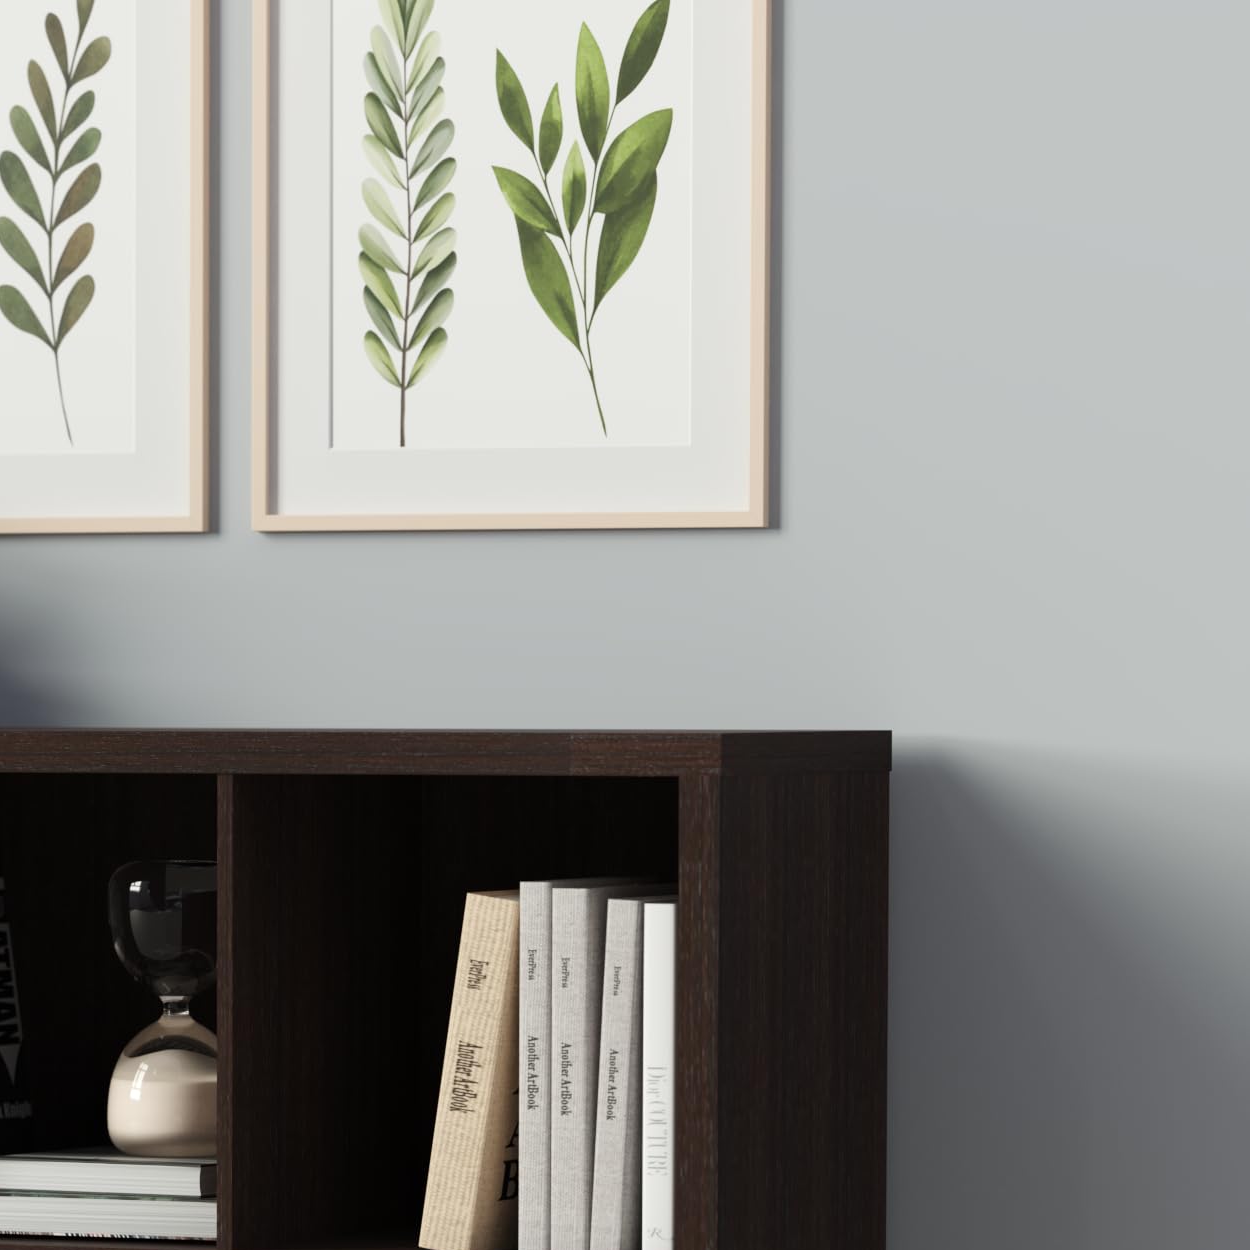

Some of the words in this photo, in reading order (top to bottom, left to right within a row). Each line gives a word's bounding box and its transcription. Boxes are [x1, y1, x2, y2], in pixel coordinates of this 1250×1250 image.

[466, 958, 490, 990] EverPress
[527, 949, 538, 981] EverPress
[561, 957, 571, 988] EverPress
[613, 965, 622, 996] EverPress
[455, 1039, 484, 1076] Another
[527, 1035, 540, 1072] Another
[560, 1042, 573, 1080] Another
[608, 1048, 620, 1083] Another
[449, 1076, 479, 1114] ArtBook
[527, 1072, 540, 1111] ArtBook
[560, 1080, 573, 1116] ArtBook
[606, 1084, 617, 1121] ArtBook
